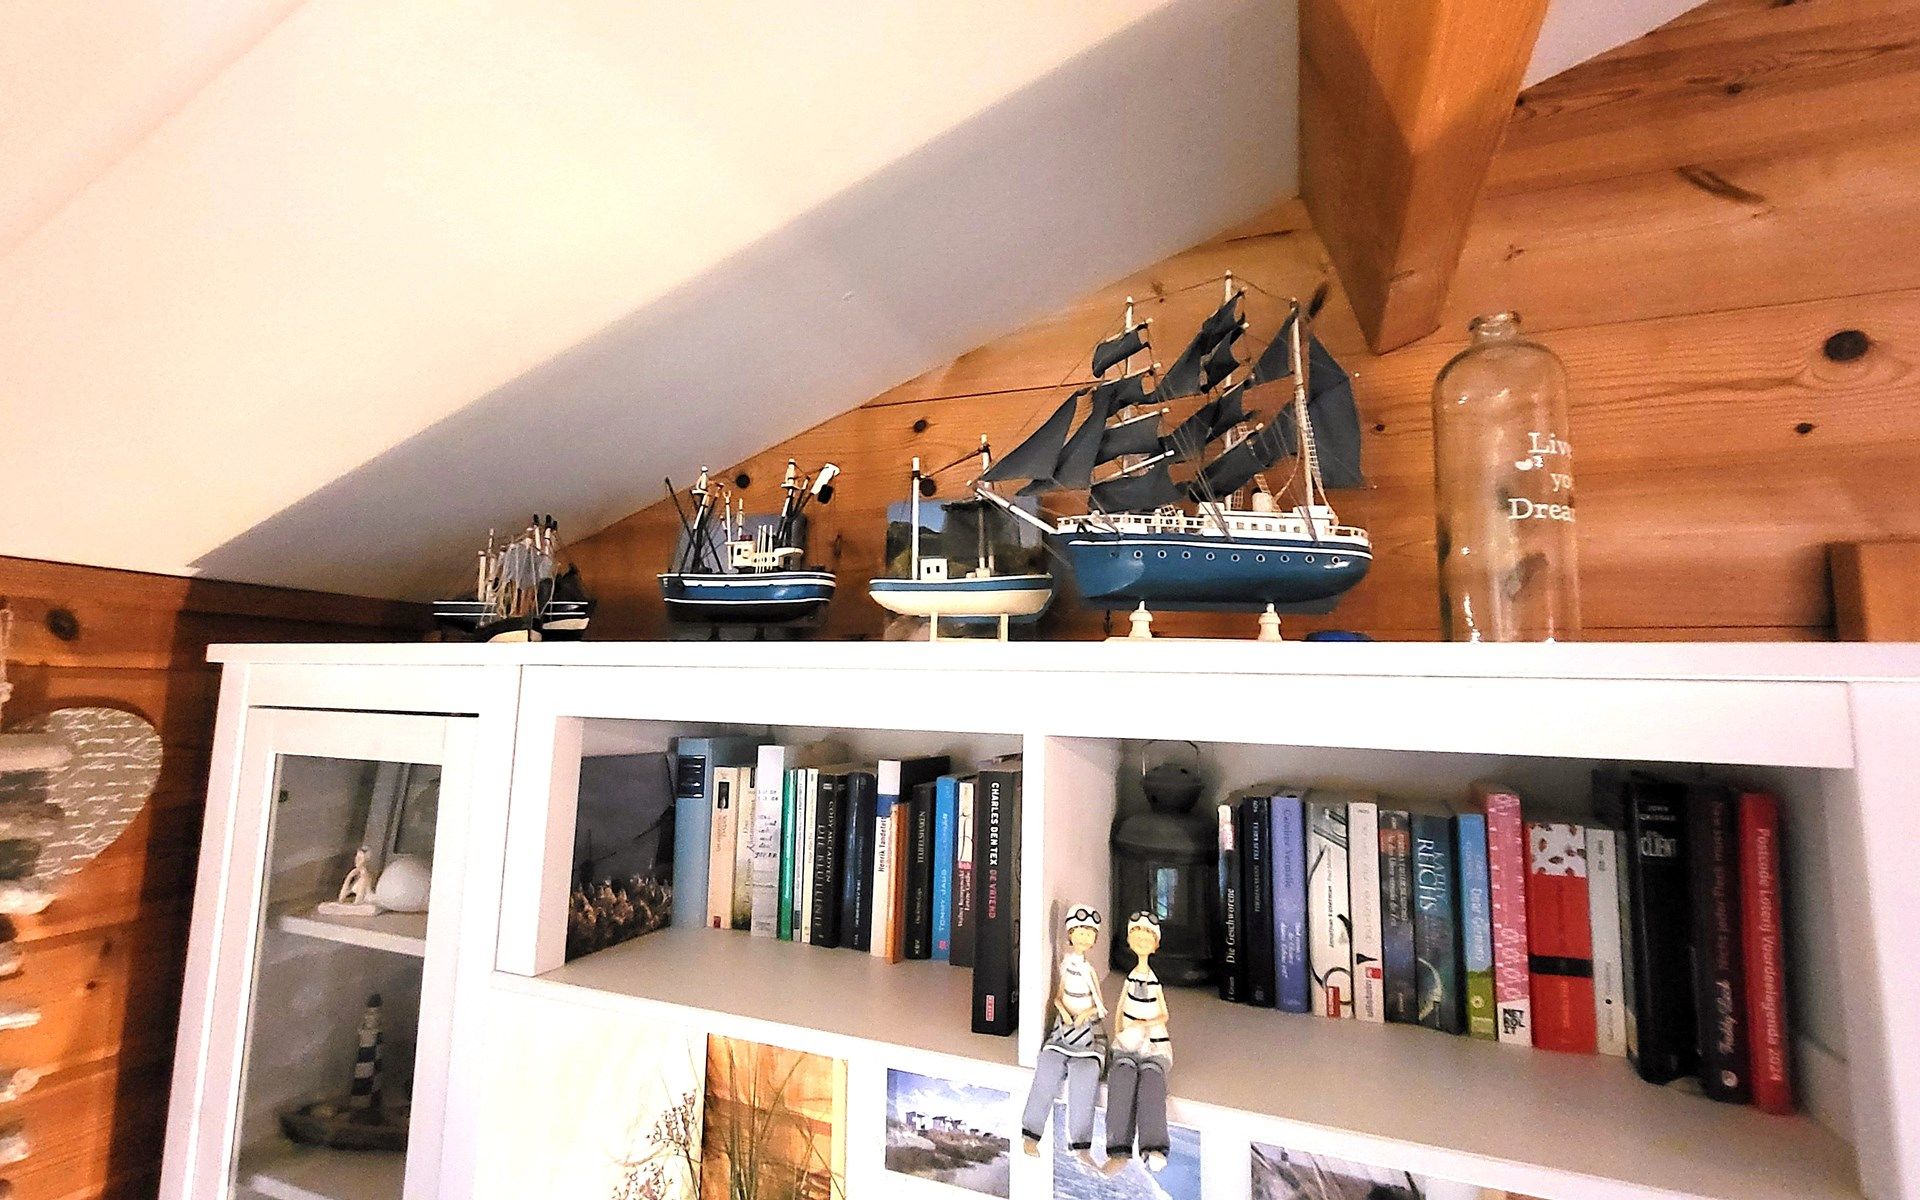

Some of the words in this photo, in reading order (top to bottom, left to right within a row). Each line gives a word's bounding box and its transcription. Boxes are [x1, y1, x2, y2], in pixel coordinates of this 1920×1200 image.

[990, 782, 999, 823] CHARLES
[990, 825, 998, 842] DEN
[878, 849, 887, 872] Henrik
[990, 844, 998, 865] TEX
[1756, 828, 1770, 887] Postcode
[990, 868, 997, 880] DE
[1418, 838, 1436, 910] REICHS
[987, 883, 996, 919] VRIEND
[1226, 887, 1235, 942] Geschworene
[1759, 889, 1774, 932] Loterij
[1226, 943, 1235, 964] Die
[1768, 1048, 1782, 1080] 2024
